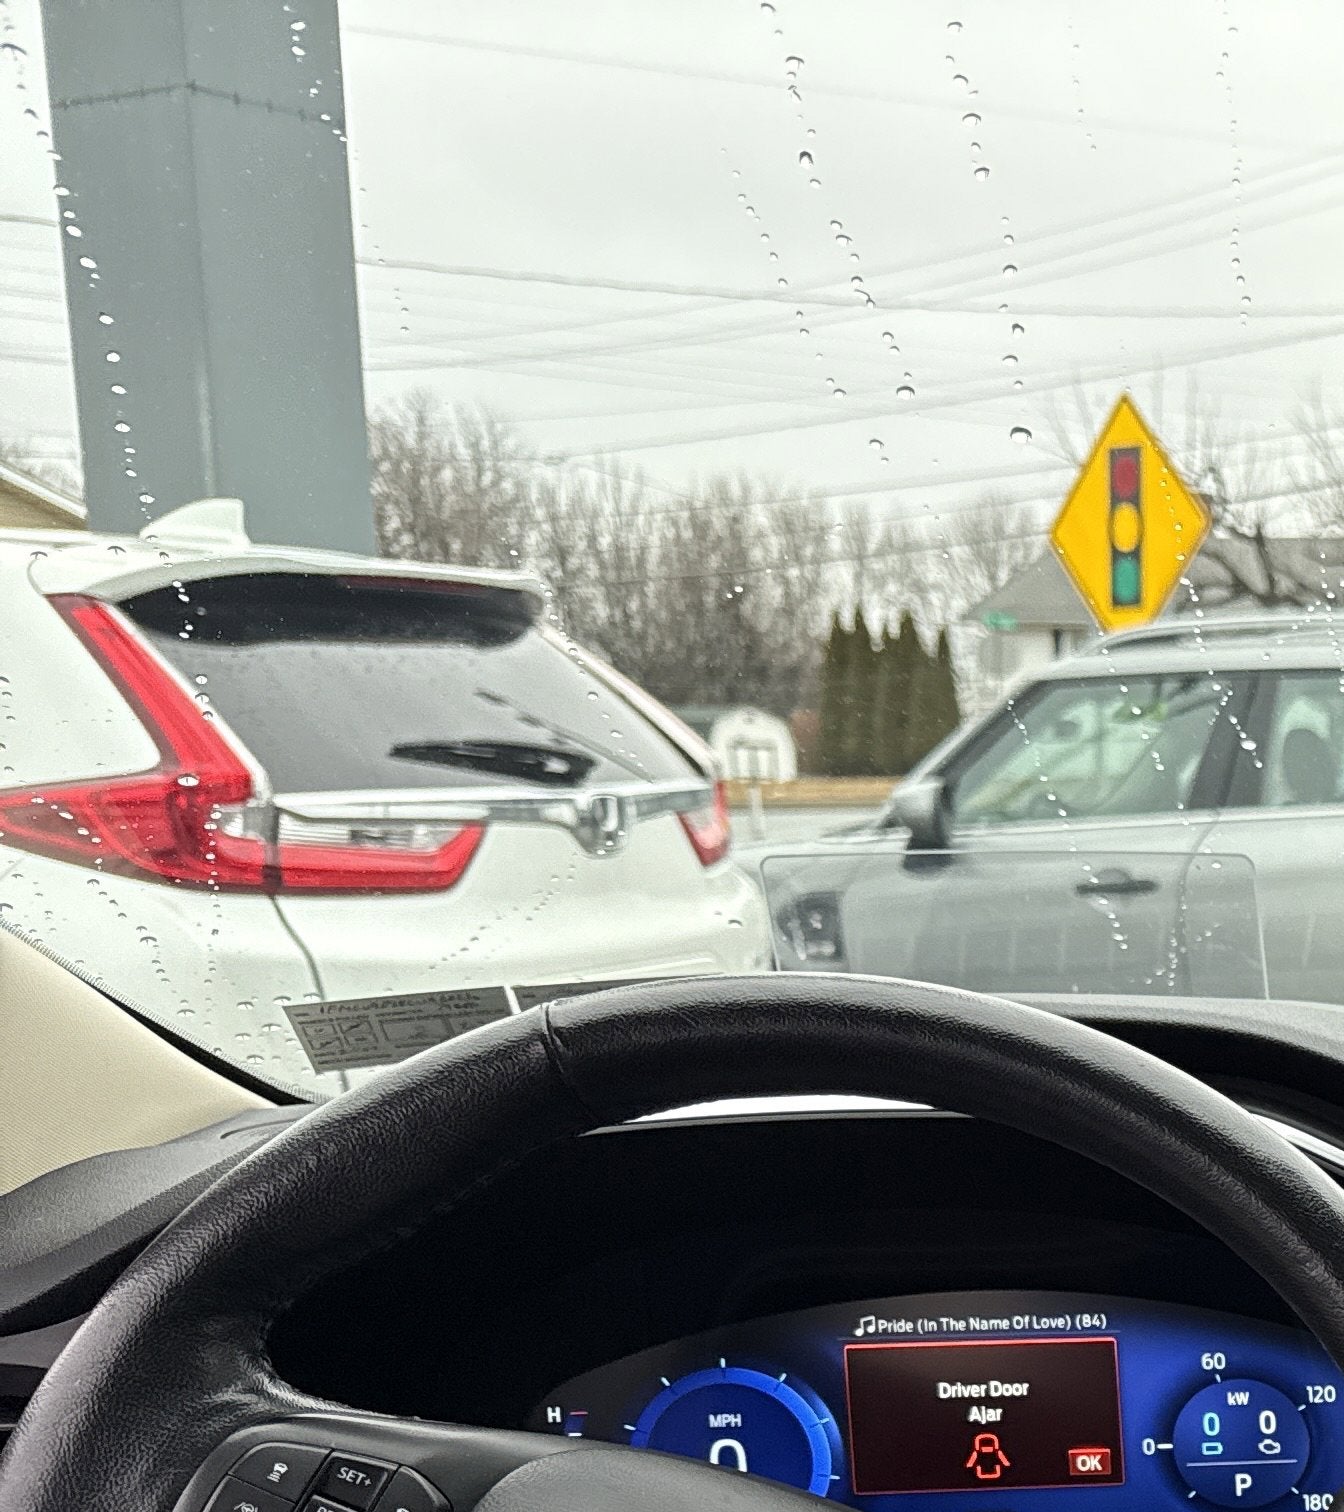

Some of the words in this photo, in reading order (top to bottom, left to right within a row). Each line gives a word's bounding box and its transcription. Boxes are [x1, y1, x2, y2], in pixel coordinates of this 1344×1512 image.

[877, 1319, 913, 1334] Pride
[918, 1319, 937, 1335] (In
[939, 1318, 966, 1331] The
[969, 1317, 1010, 1331] Name
[1013, 1316, 1029, 1329] Of
[1031, 1316, 1072, 1330] Love)
[1075, 1314, 1107, 1330] (84)
[1202, 1352, 1226, 1370] 60
[938, 1382, 988, 1399] Driver
[989, 1381, 1029, 1398] Door
[1227, 1391, 1249, 1406] kW
[1306, 1385, 1336, 1403] 120
[547, 1406, 561, 1423] H
[709, 1414, 742, 1428] MPH
[969, 1406, 1003, 1424] Ajar
[1203, 1412, 1220, 1436] 0
[1259, 1410, 1277, 1435] 0
[1143, 1438, 1156, 1455] 0
[1076, 1456, 1102, 1472] OK
[336, 1466, 372, 1487] SET+
[1235, 1473, 1252, 1496] P
[1303, 1494, 1333, 1511] 180
